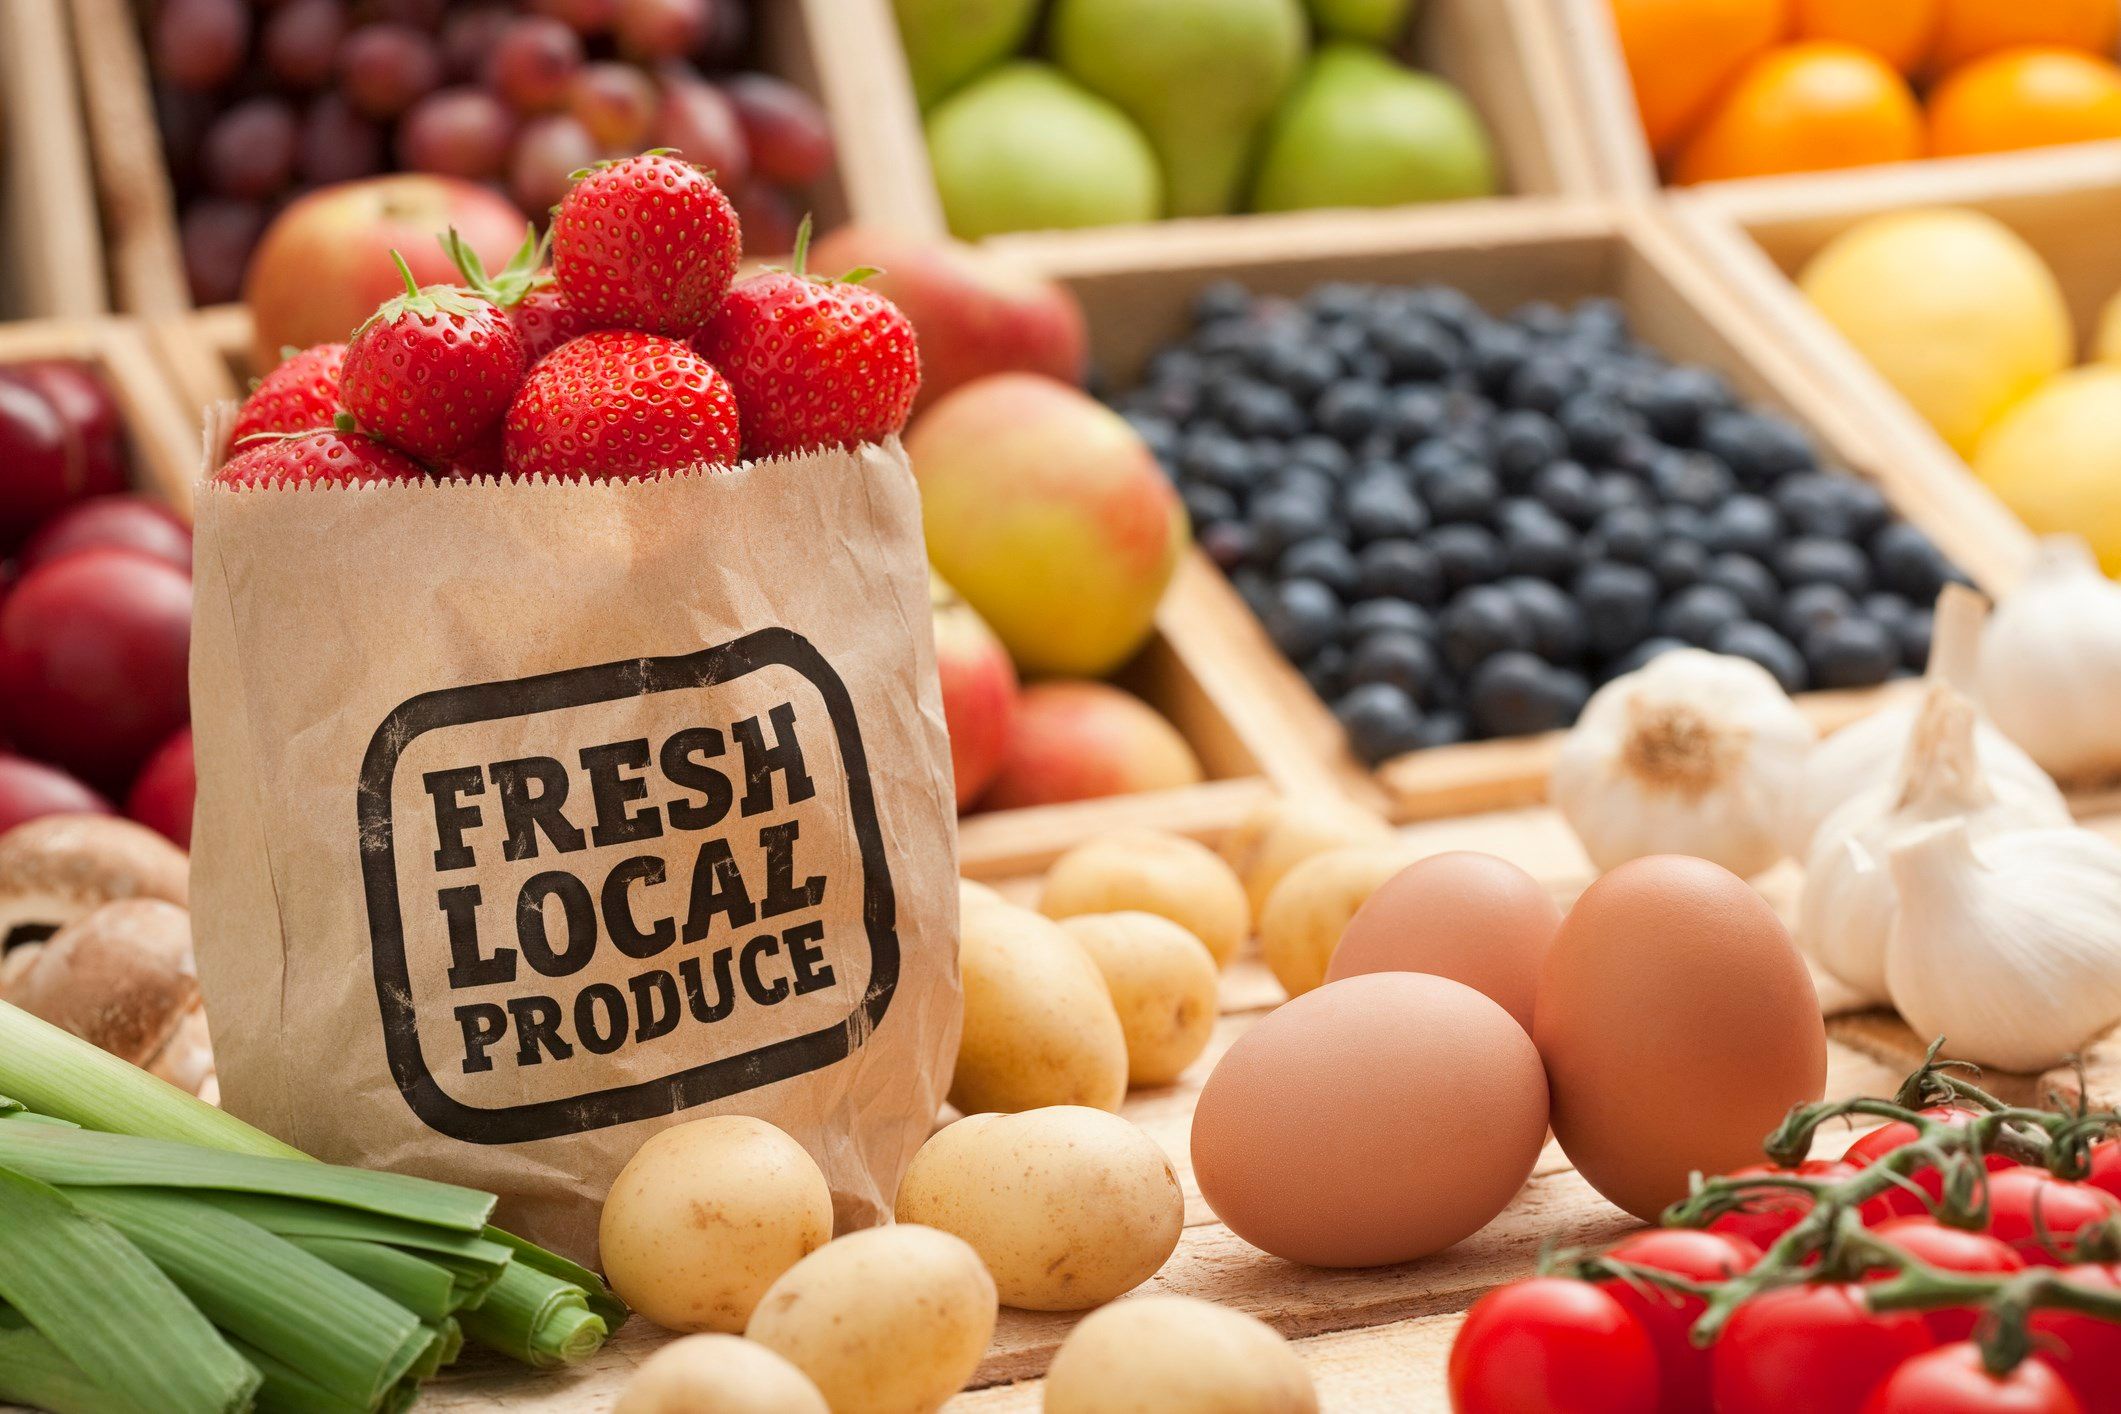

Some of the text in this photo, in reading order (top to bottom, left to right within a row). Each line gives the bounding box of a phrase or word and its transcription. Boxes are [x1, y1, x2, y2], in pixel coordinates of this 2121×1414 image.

[422, 701, 816, 872] FRESH
[437, 819, 828, 990] LOCAL
[453, 919, 837, 1074] PRODUCE
